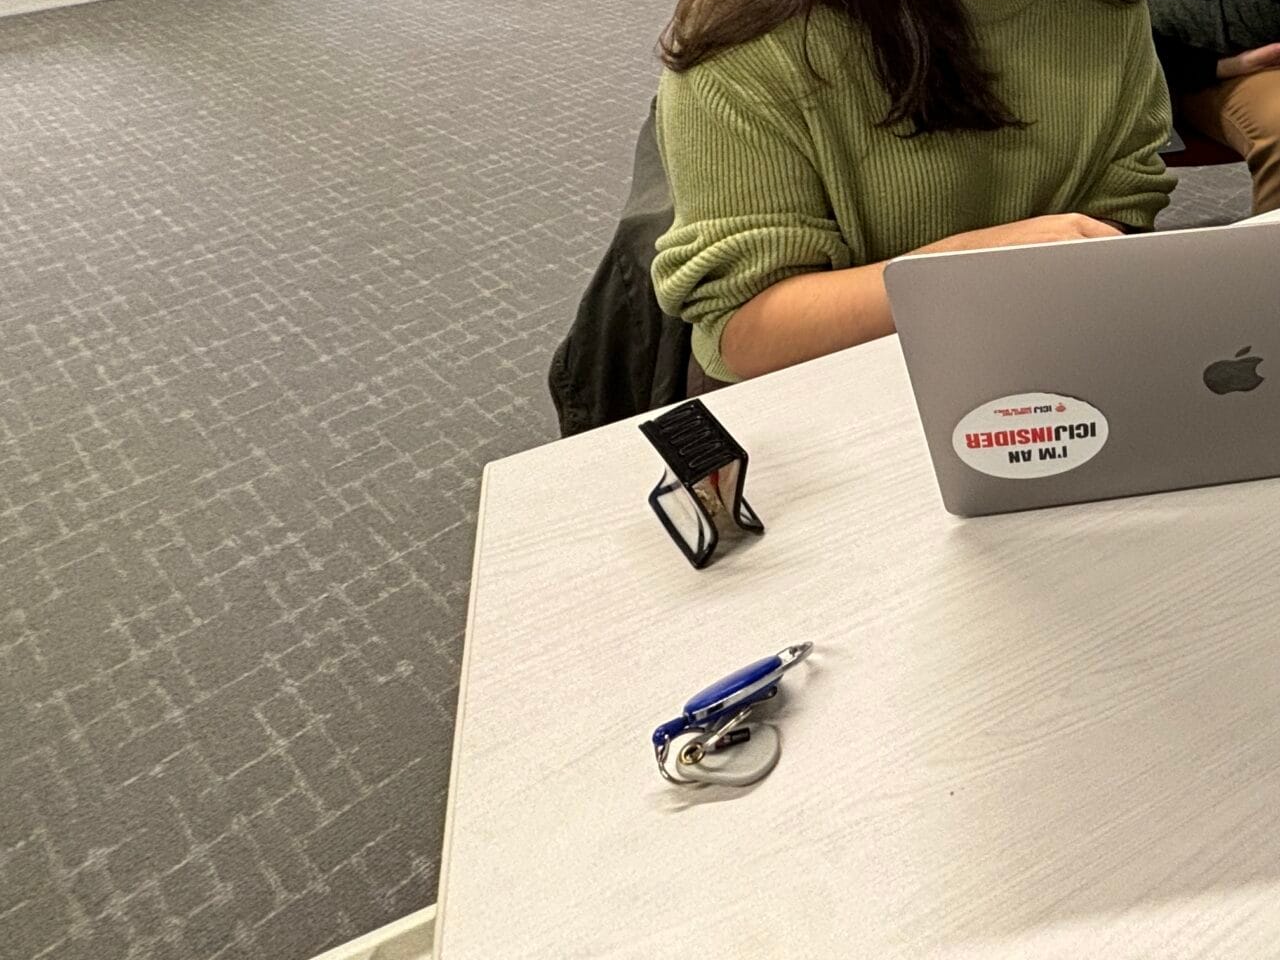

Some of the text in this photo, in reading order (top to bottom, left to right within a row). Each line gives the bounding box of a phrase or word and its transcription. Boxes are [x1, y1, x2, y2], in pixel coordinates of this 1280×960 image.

[965, 422, 1096, 449] ICIJINSIDER
[1008, 445, 1068, 464] I'M AN
